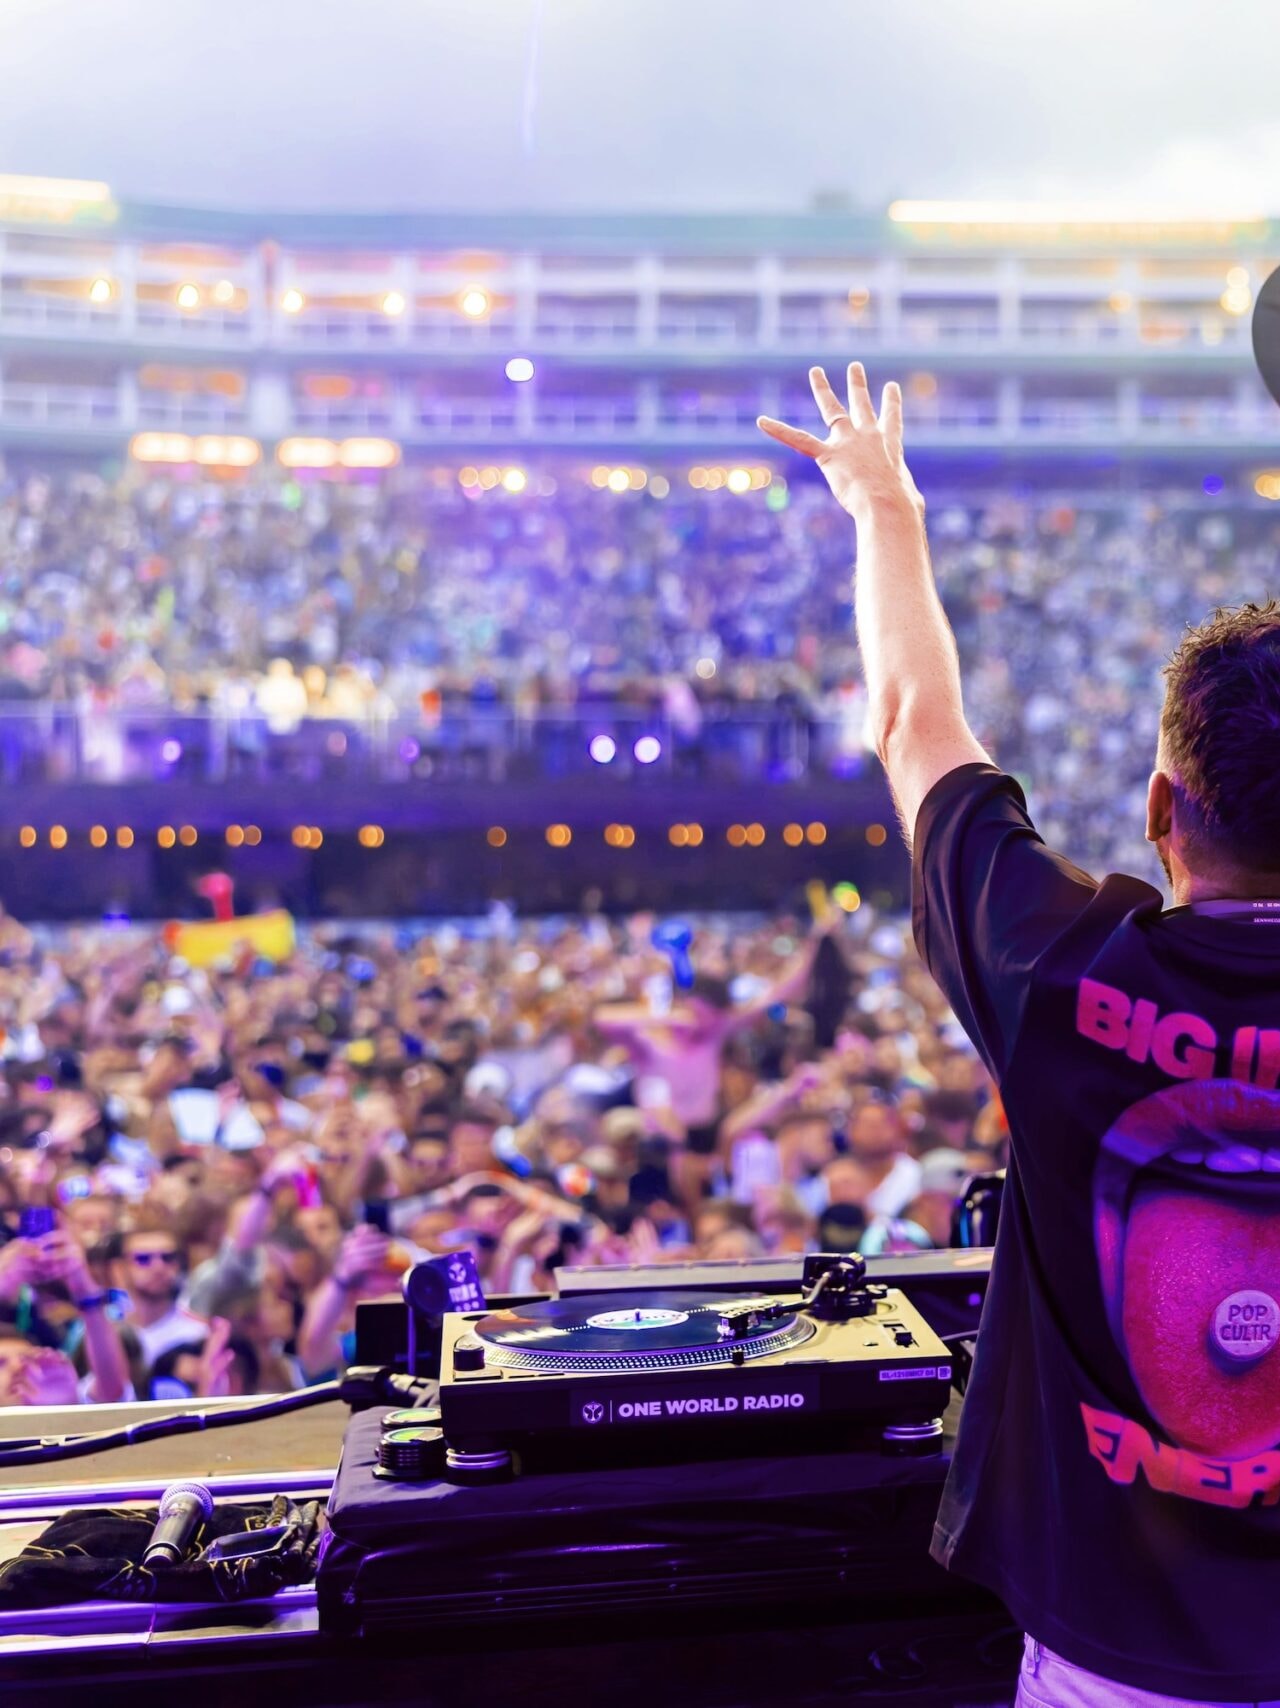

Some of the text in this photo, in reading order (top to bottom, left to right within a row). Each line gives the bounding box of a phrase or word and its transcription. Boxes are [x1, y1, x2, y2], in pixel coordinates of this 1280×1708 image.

[1077, 978, 1217, 1080] BIG
[1228, 1304, 1268, 1321] POP
[1220, 1324, 1271, 1341] CULTR
[618, 1393, 805, 1418] ONE WORLD RADIO
